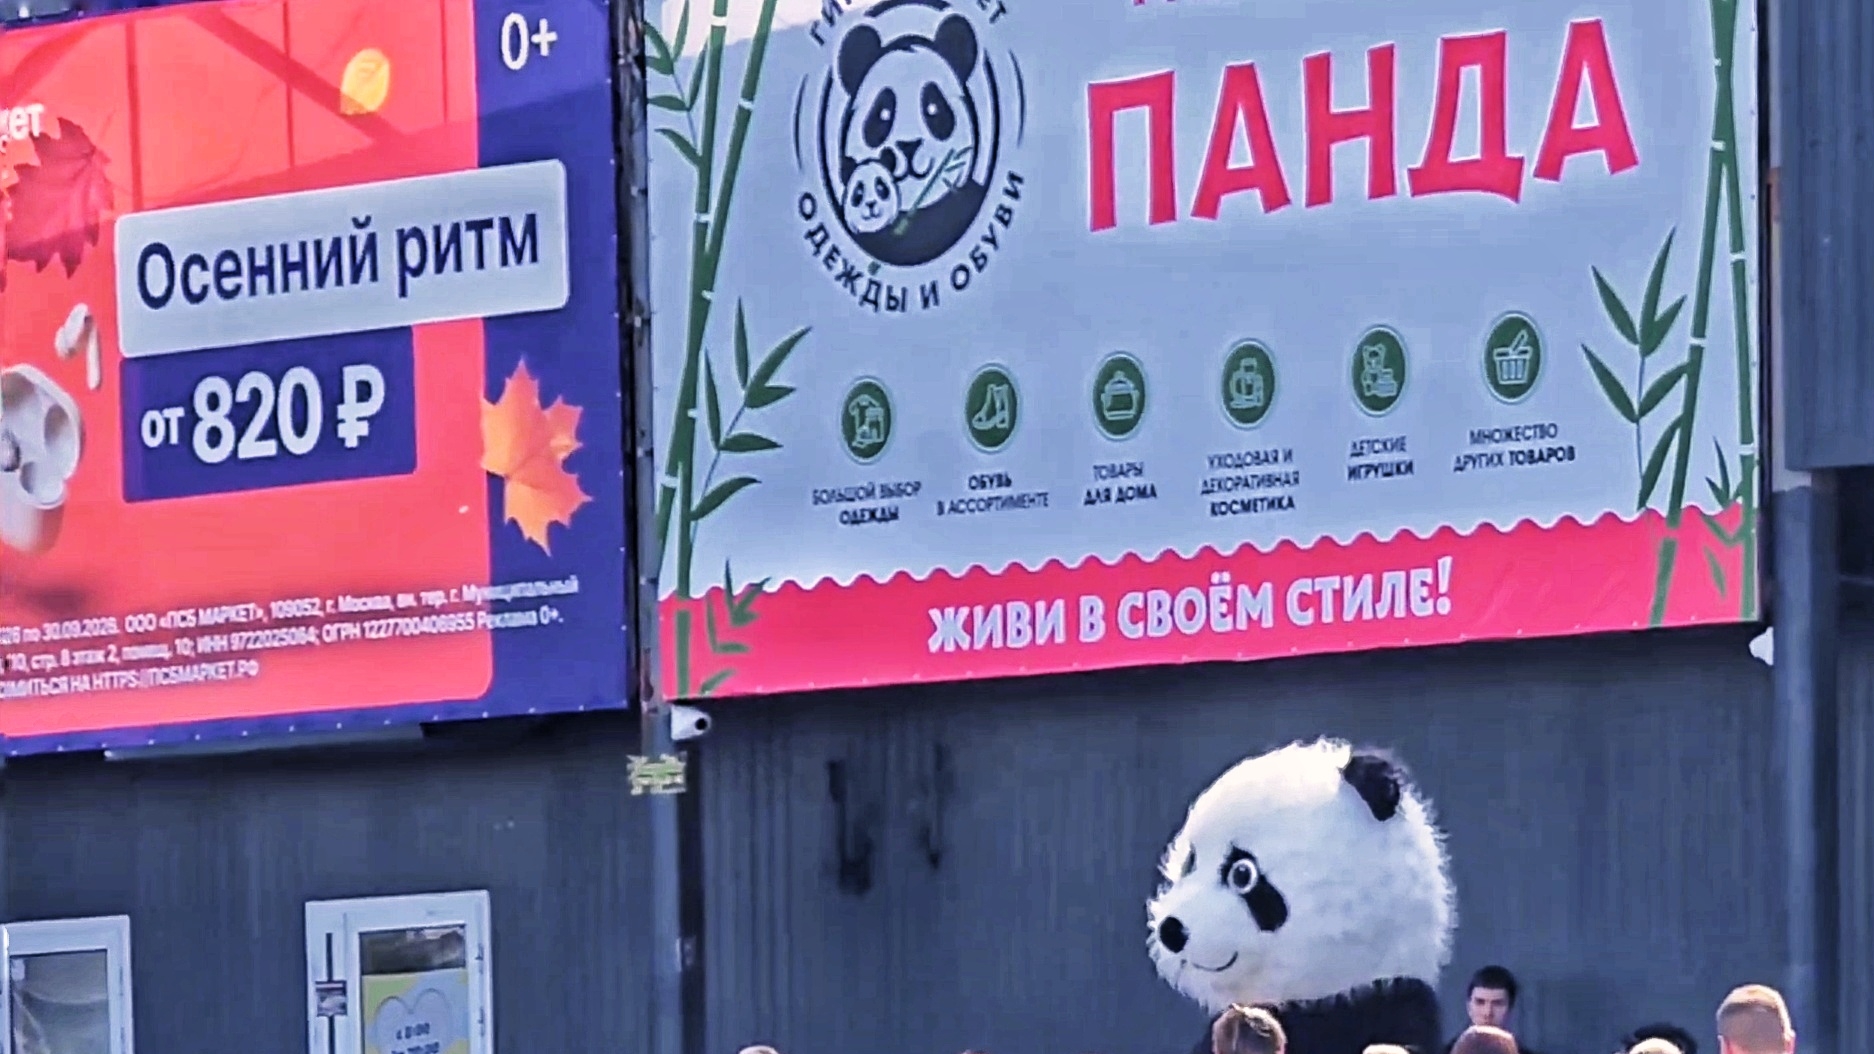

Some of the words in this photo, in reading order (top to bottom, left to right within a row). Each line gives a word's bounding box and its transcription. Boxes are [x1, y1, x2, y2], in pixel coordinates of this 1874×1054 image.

[501, 13, 557, 71] 0+
[1087, 17, 1640, 233] ПАНДА
[799, 190, 907, 313] ОДЕЖДЫ
[920, 279, 940, 310] И
[953, 170, 1026, 292] ОБУВИ
[136, 215, 379, 310] Осенний
[397, 212, 540, 298] ритм
[141, 405, 184, 448] от
[191, 365, 323, 465] 820
[1469, 422, 1558, 446] МНОЖЕСТВО
[1349, 435, 1408, 458] ДЕТСКИЕ
[1092, 461, 1145, 481] ТОВАРЫ
[1206, 449, 1280, 470] УХОДОВАЯ
[1282, 448, 1294, 463] И
[1347, 459, 1415, 481] ИГРУШКИ
[1453, 451, 1505, 473] ДРУГИХ
[1508, 445, 1576, 467] ТОВАРОВ
[812, 481, 877, 506] БОЛЬШОЙ
[879, 480, 922, 500] ВЫБОР
[968, 471, 1013, 491] ОБУВЬ
[1200, 470, 1300, 496] ДЕКОРАТИВНАЯ
[936, 500, 945, 516] В
[947, 491, 1050, 515] АССОРТИМЕНТЕ
[1083, 487, 1112, 506] ДЛЯ
[1114, 483, 1158, 504] ДОМА
[1210, 495, 1296, 517] КОСМЕТИКА
[838, 506, 900, 526] ОДЕЖДЫ
[927, 598, 1066, 654] ЖИВИ
[1079, 594, 1106, 643] В
[1117, 571, 1275, 639] СВОЁМ
[1285, 555, 1453, 628] СТИЛЕ!
[124, 613, 157, 633] ООО
